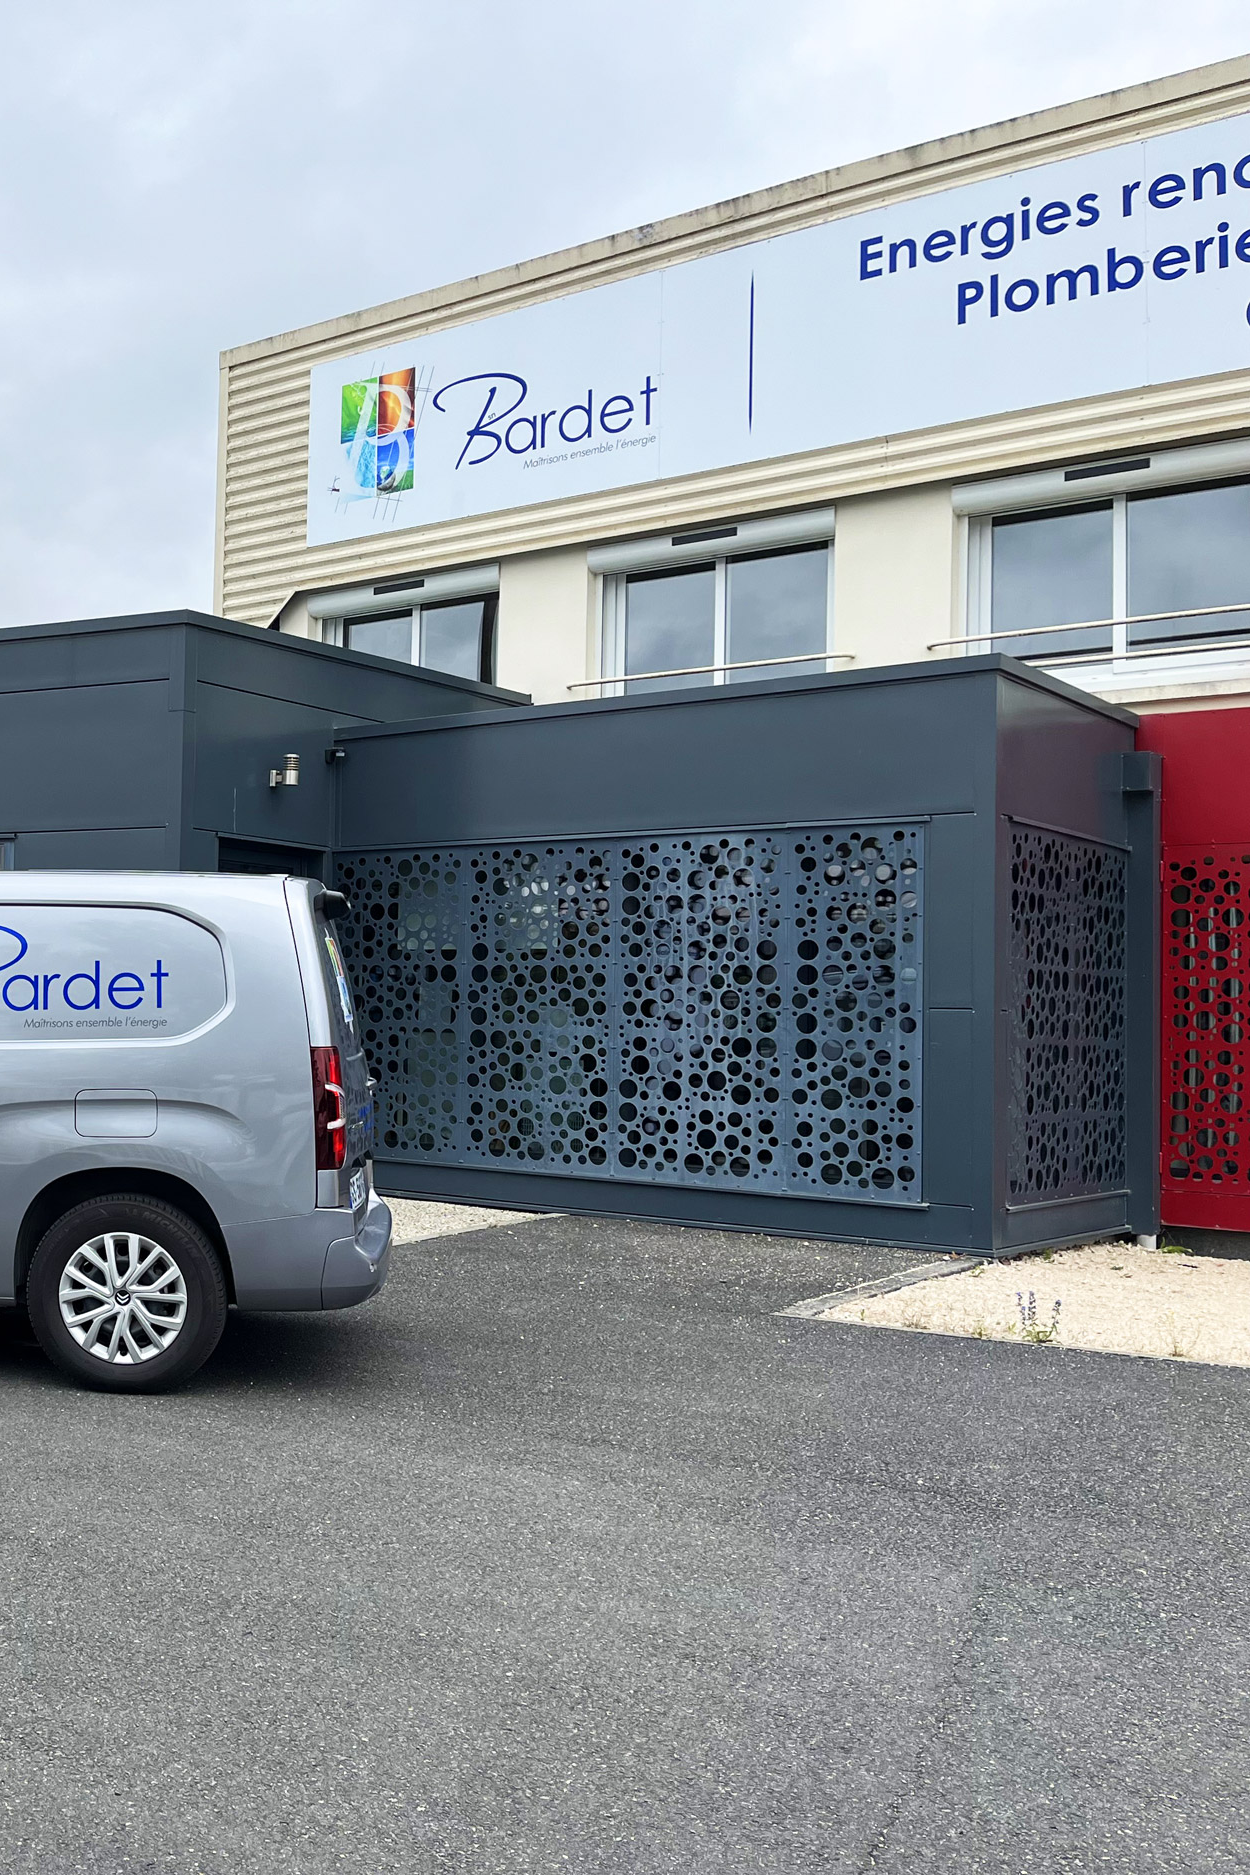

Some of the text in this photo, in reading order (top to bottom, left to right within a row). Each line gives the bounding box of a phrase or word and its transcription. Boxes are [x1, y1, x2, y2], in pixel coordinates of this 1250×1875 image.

[859, 193, 1100, 281] Energies
[432, 372, 658, 470] Bardet
[522, 452, 569, 470] Maîtrisons
[570, 441, 614, 460] ensemble
[23, 1018, 74, 1029] Maîtrisons
[75, 1016, 123, 1028] ensemble
